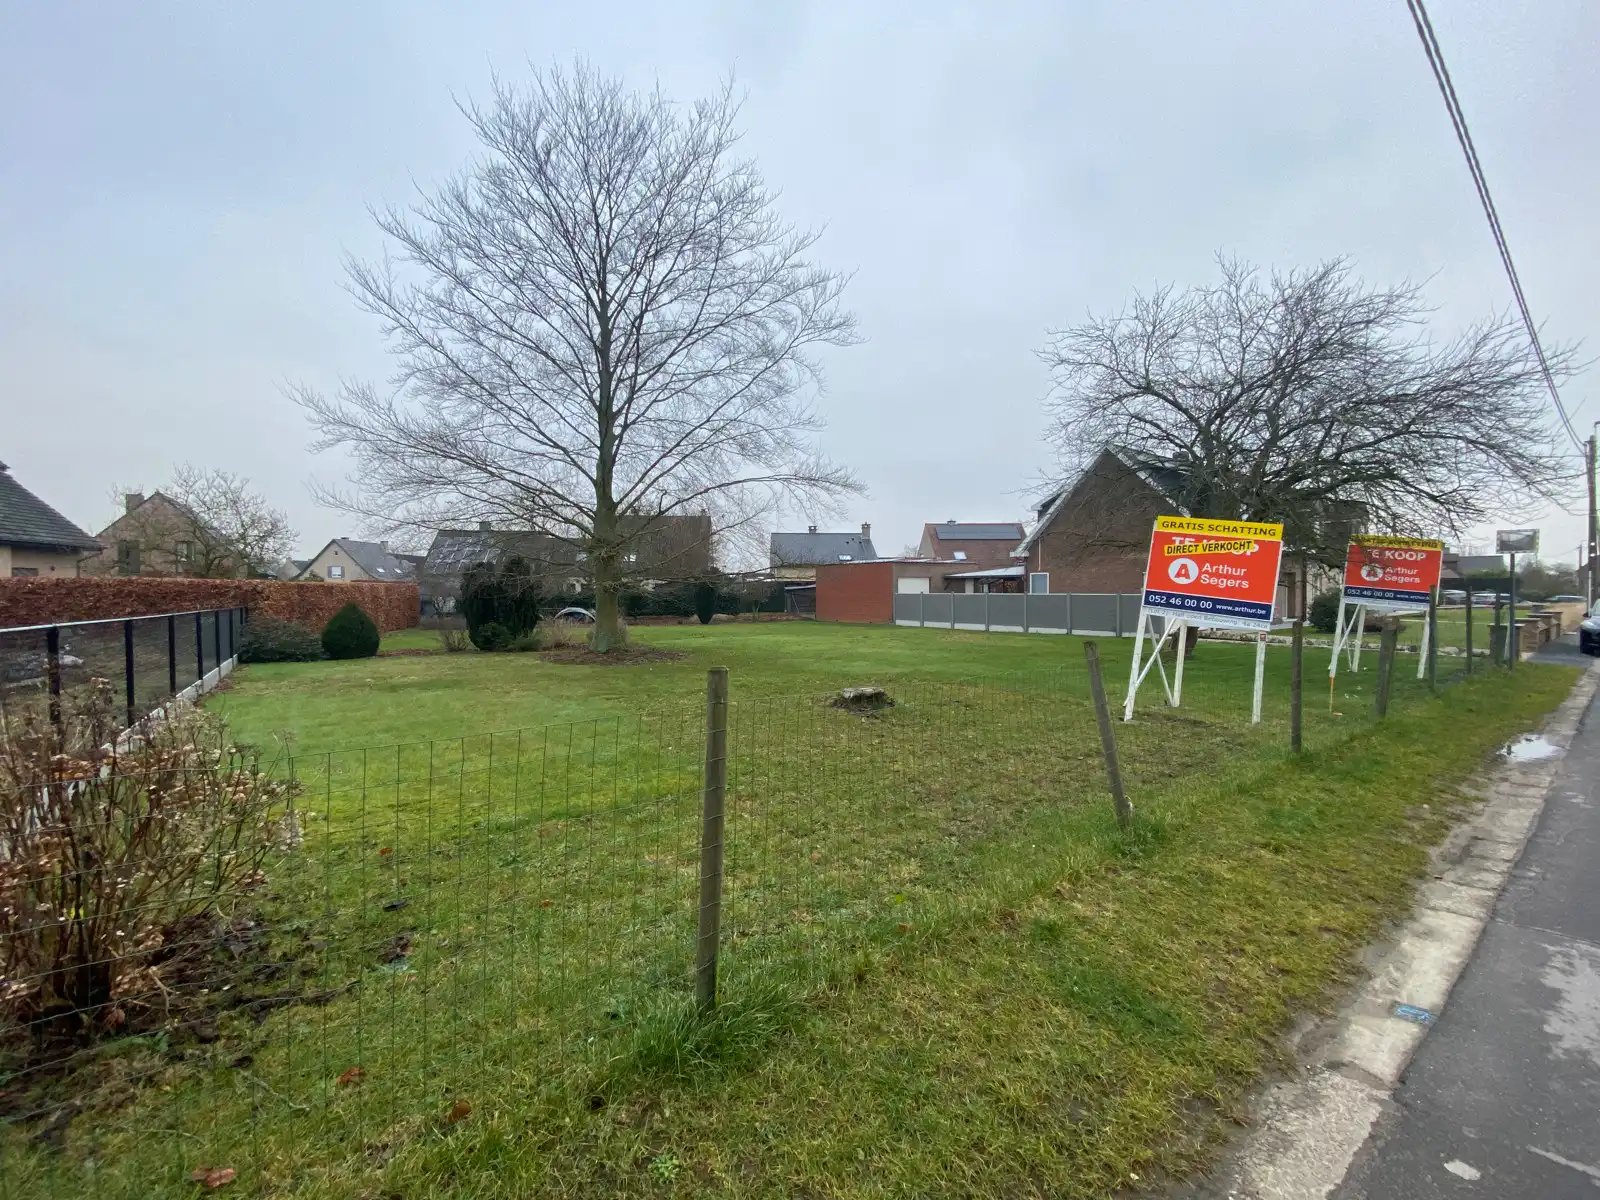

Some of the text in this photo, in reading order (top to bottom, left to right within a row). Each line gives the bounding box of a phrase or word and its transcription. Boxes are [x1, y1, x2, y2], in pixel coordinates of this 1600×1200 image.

[1162, 520, 1276, 536] GRATIS SCHATTING
[1166, 544, 1199, 554] DIRECT
[1202, 540, 1252, 552] VERKOCHT
[1385, 550, 1426, 560] KOOP
[1201, 563, 1247, 576] Arthur
[1385, 566, 1418, 575] Arthur
[1200, 573, 1249, 589] Segers
[1384, 574, 1420, 584] Segers
[1148, 594, 1267, 615] 052 46 00 00 www.arthur.be
